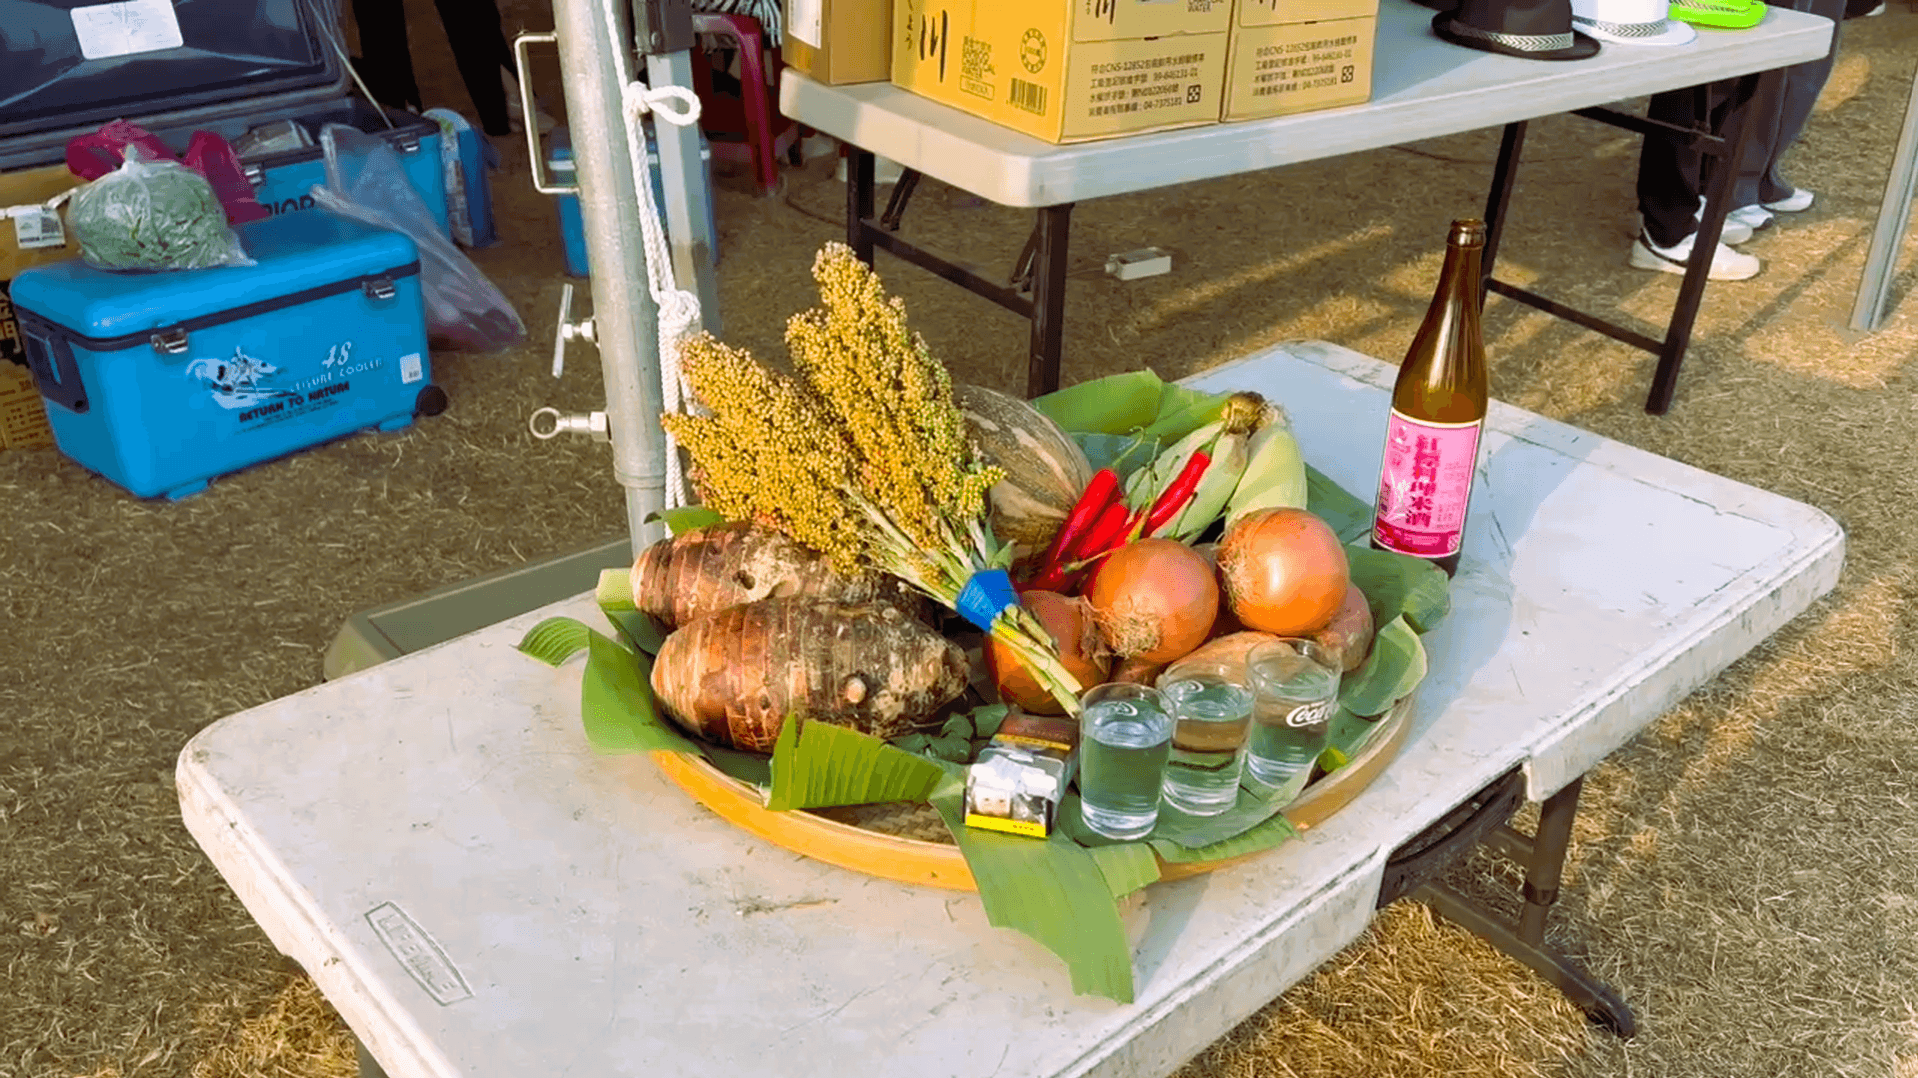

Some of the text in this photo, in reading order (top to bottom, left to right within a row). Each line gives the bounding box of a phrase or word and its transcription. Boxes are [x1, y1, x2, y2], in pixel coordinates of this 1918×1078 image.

[239, 401, 284, 423] RETURN
[289, 395, 305, 408] TO
[308, 380, 350, 402] NATURE
